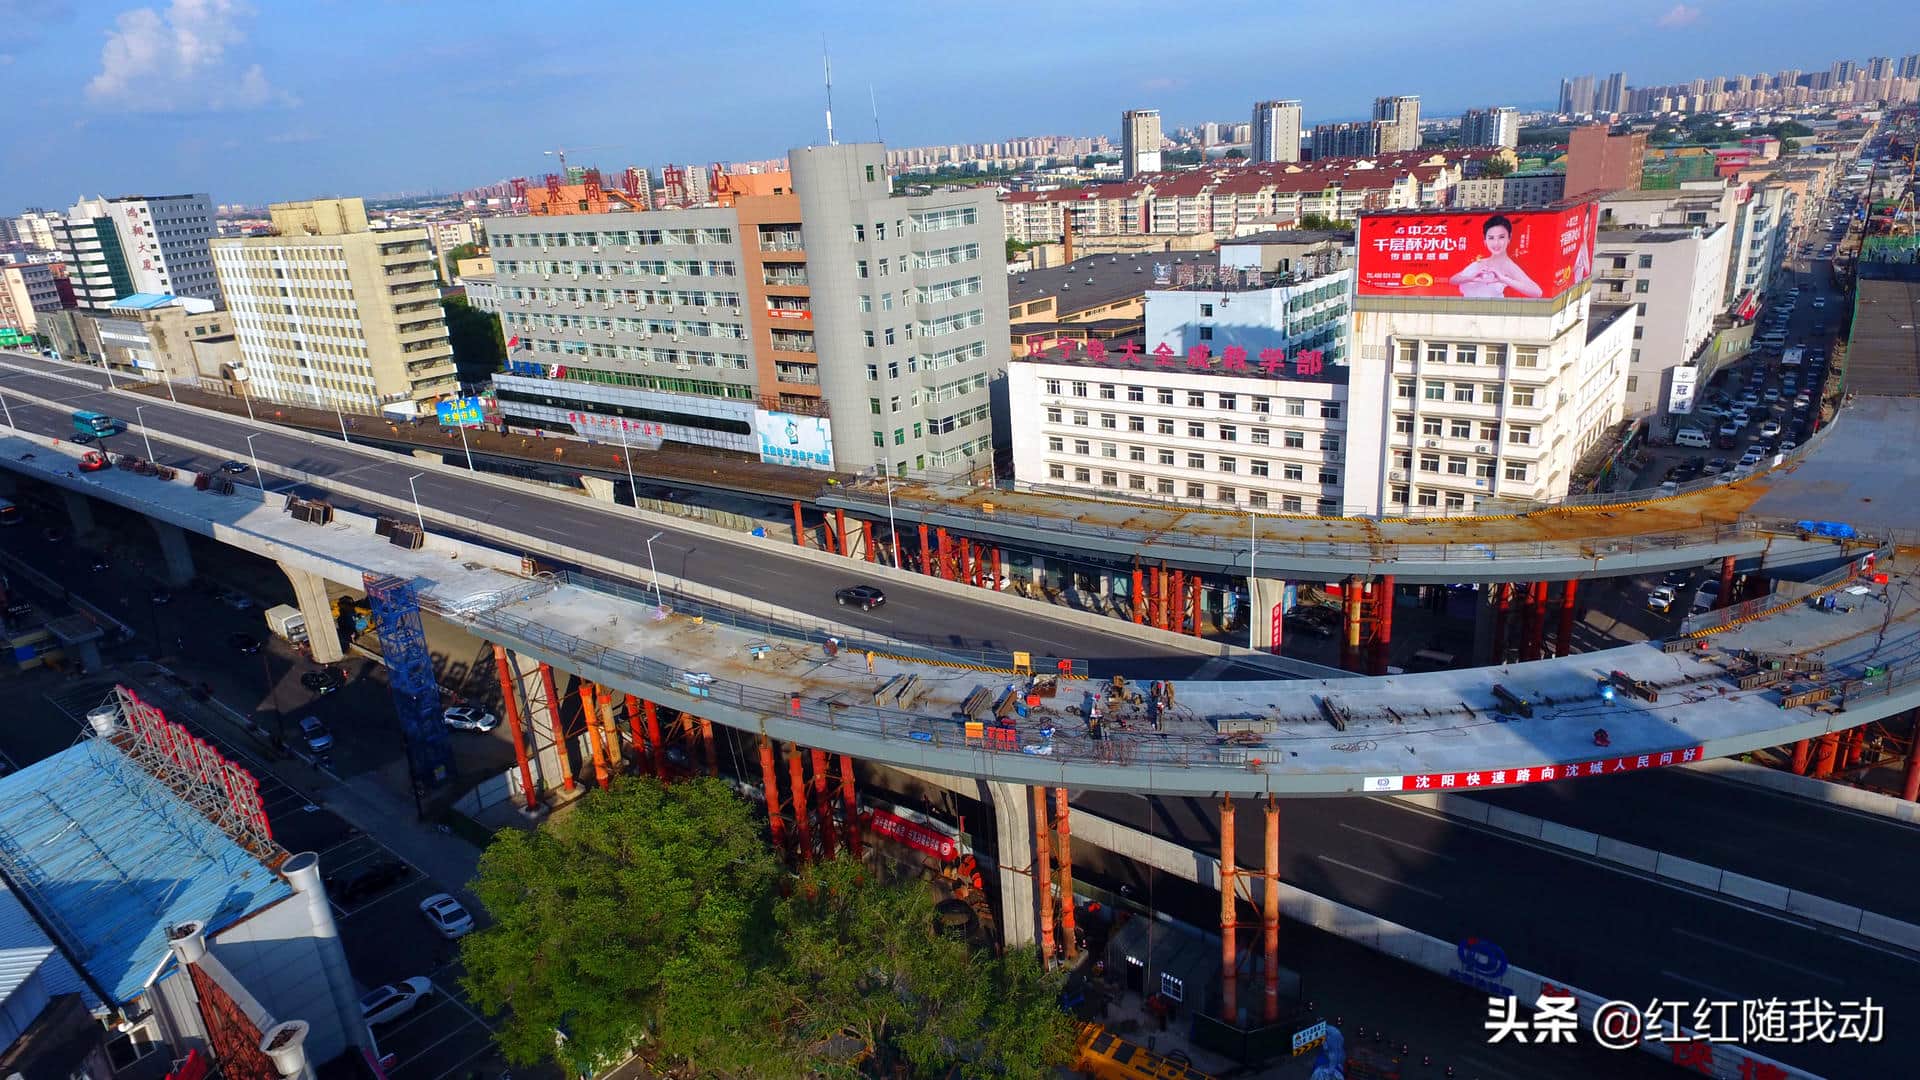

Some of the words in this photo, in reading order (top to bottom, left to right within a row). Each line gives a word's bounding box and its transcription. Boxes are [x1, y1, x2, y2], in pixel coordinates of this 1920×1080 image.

[511, 162, 730, 204] 万泉商业中心
[1408, 225, 1448, 235] 中之杰
[1373, 237, 1457, 252] 千层酥冰心
[1415, 748, 1697, 789] 沈阳快速路向沈城人民问好
